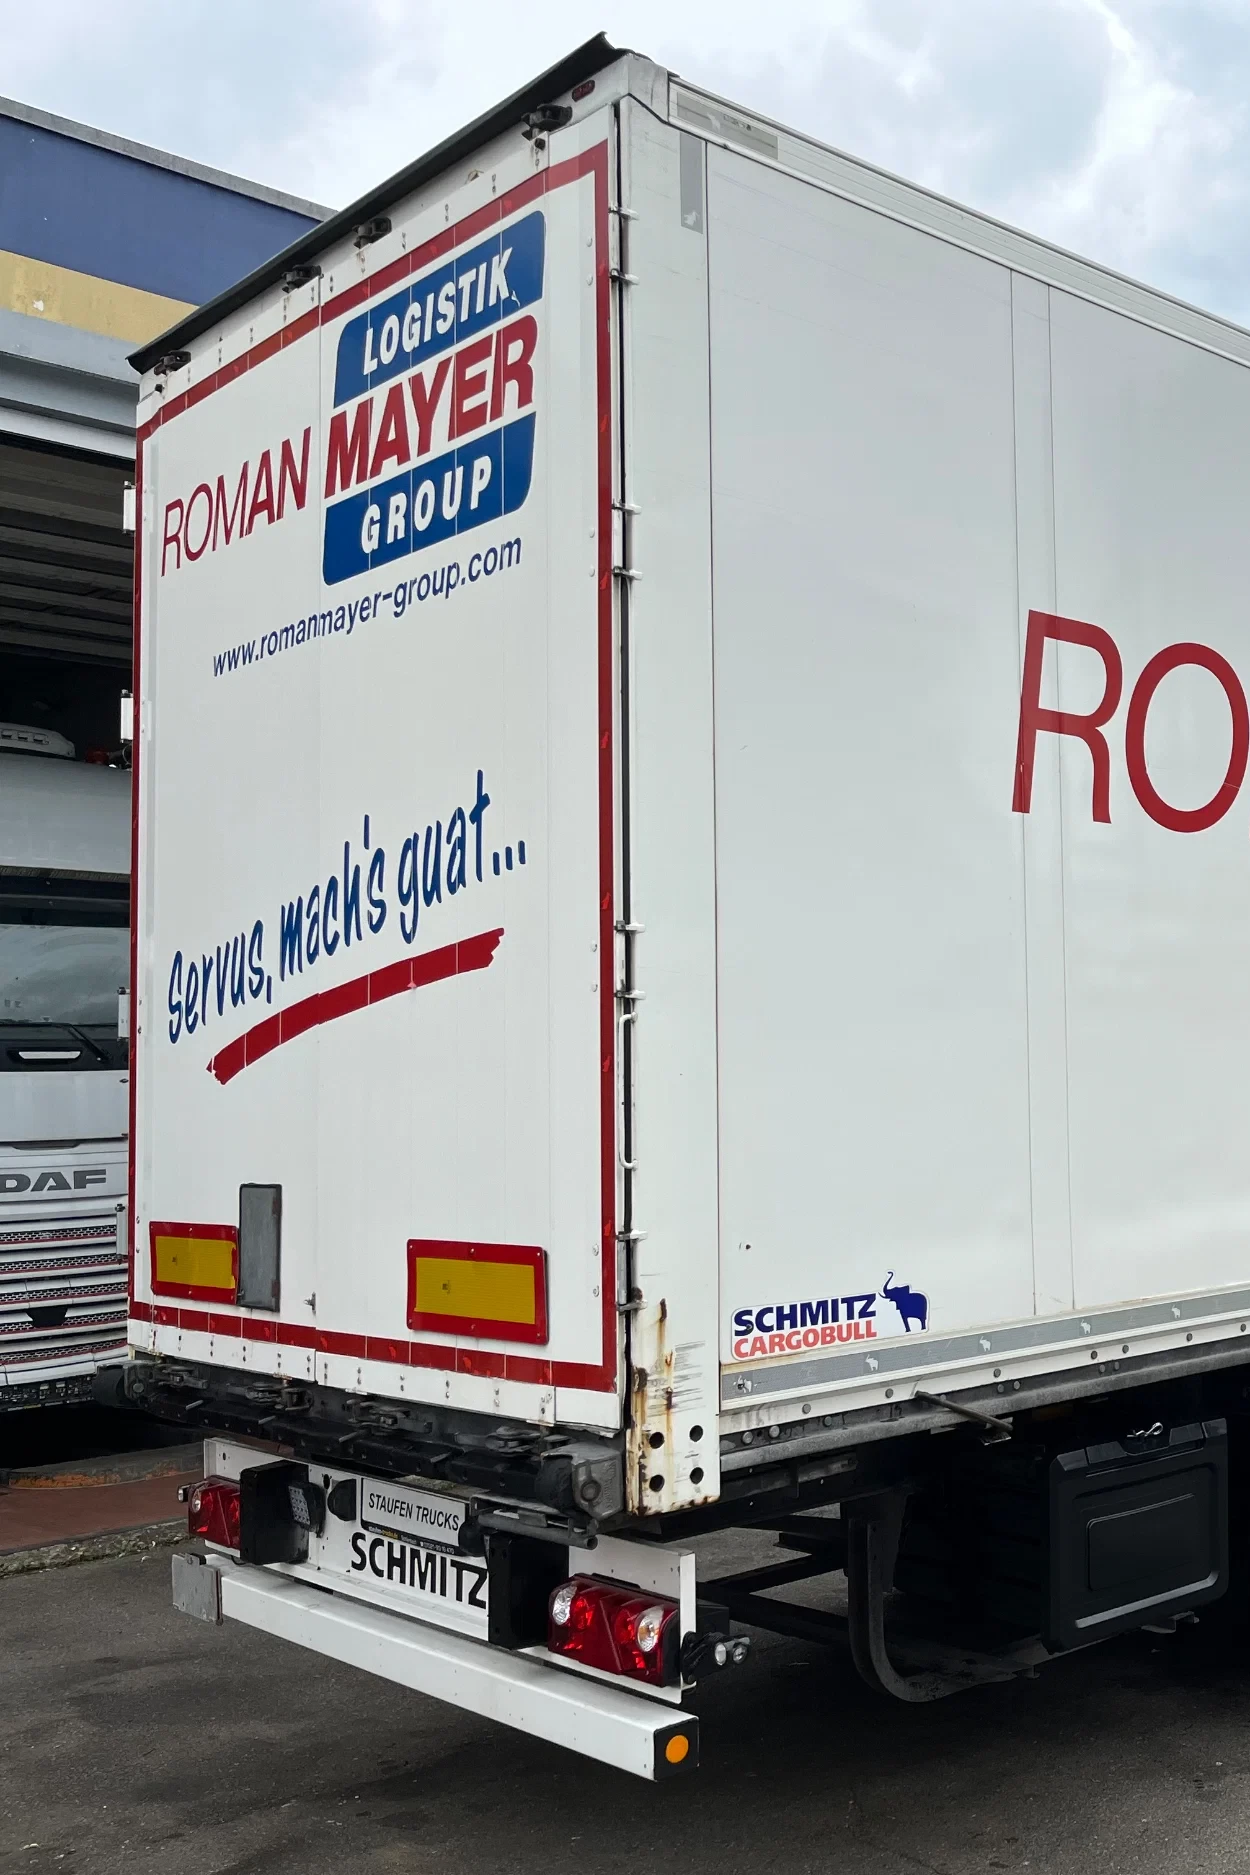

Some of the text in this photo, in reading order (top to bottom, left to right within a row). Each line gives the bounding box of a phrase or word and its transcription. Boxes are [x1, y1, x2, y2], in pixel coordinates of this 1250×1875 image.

[363, 247, 513, 376] LOGISTIK
[161, 315, 539, 577] ROMAN MAYER
[360, 455, 492, 554] GROUP
[212, 536, 522, 677] www.romanmayer-group.com
[168, 919, 273, 1044] Servus,
[279, 814, 387, 982] mach's
[0, 1168, 107, 1193] DAF
[734, 1293, 877, 1337] SCHMITZ
[734, 1320, 878, 1359] CARGOBULL
[368, 1492, 460, 1532] STAUFEN TRUCKS
[351, 1531, 489, 1610] SCHMITZ
